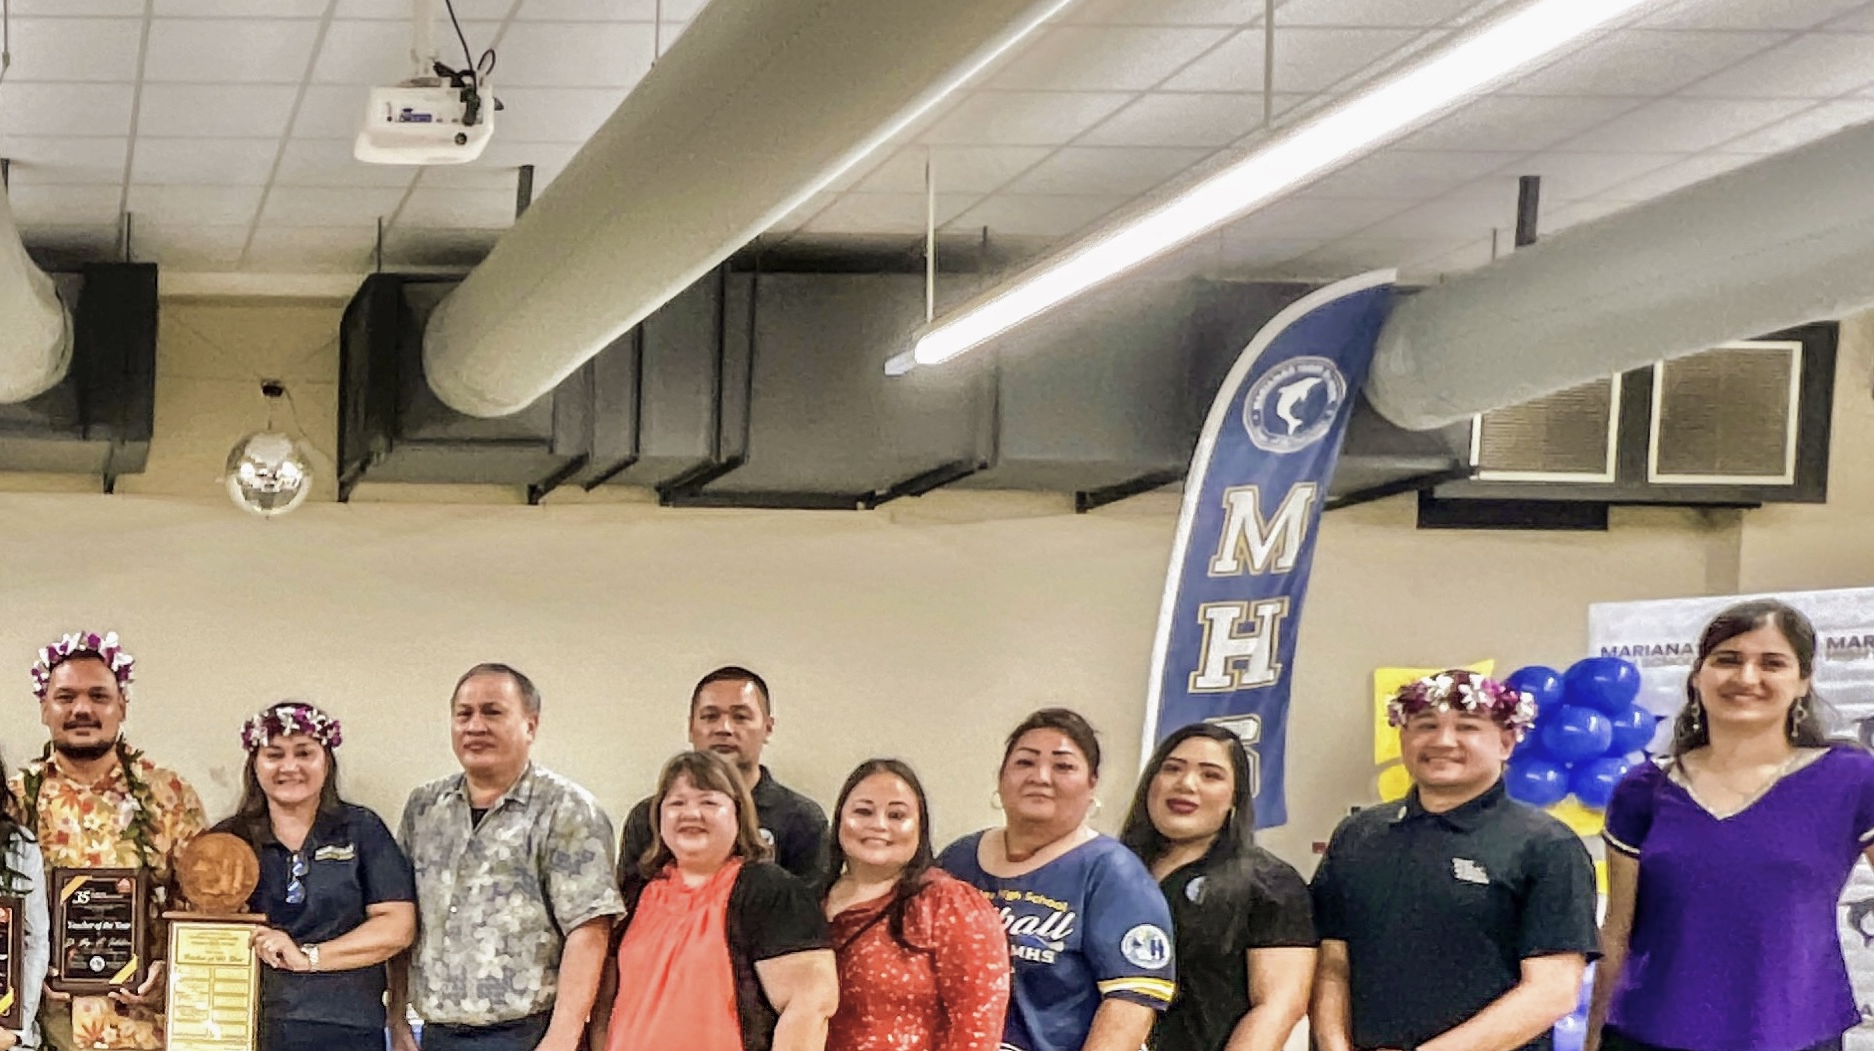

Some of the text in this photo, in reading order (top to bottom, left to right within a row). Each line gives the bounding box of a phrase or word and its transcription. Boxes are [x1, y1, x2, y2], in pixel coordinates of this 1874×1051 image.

[1600, 642, 1694, 658] MARIANA
[72, 890, 91, 905] 35
[1025, 891, 1069, 913] School
[1010, 944, 1055, 964] MHS
